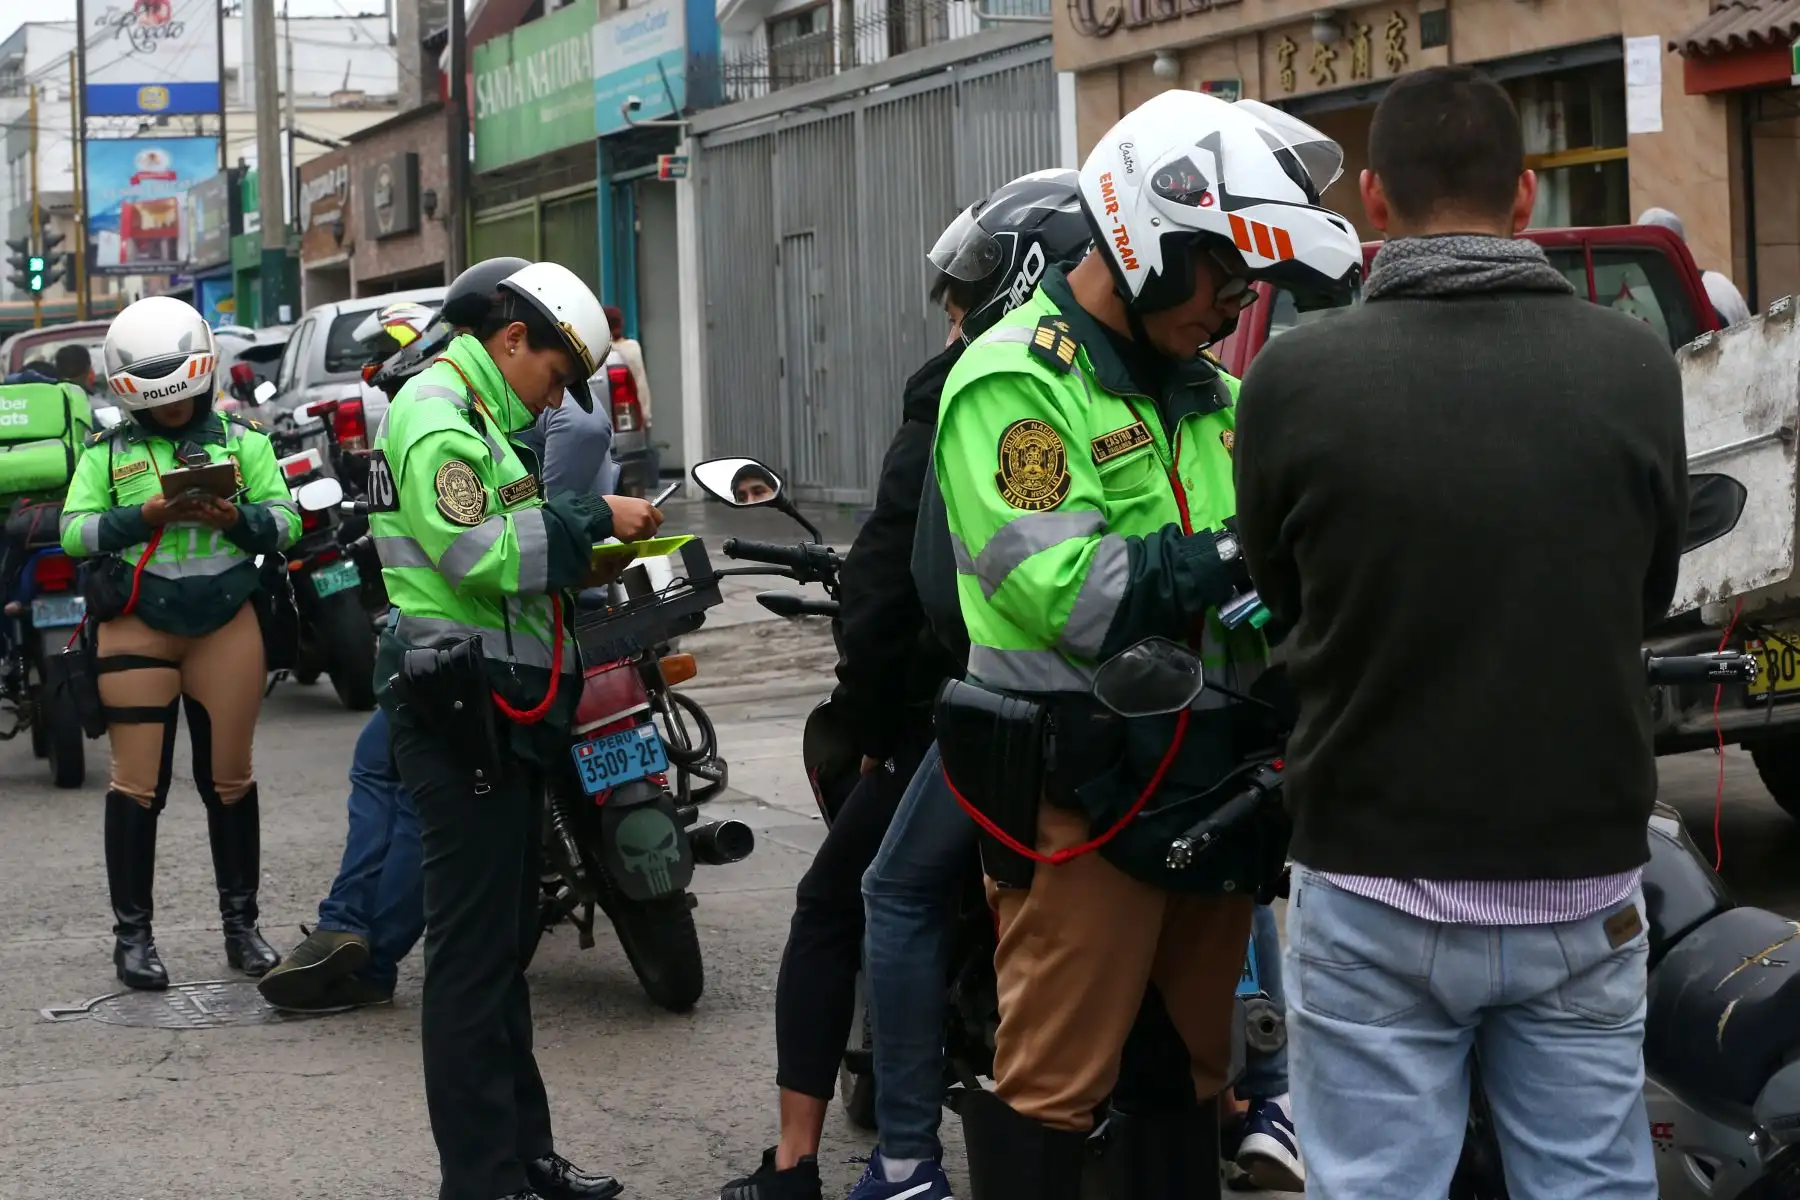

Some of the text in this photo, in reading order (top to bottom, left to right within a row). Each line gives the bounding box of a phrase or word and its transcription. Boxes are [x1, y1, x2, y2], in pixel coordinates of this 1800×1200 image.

[476, 61, 524, 119] SANTA
[526, 31, 595, 101] NATURA
[1118, 142, 1134, 174] Castro
[1002, 241, 1045, 316] HIRO
[142, 380, 188, 400] POLICIA
[0, 396, 28, 411] ber
[0, 412, 29, 426] ats
[1003, 422, 1063, 453] POLICIA NACIONAL
[1104, 429, 1132, 448] CASTRO
[368, 459, 393, 507] TO
[1007, 476, 1028, 496] PUEBLO
[1031, 487, 1052, 498] HECHO
[1002, 488, 1060, 509] DIRTTSV
[599, 733, 633, 752] PERU
[582, 738, 659, 783] 3509-2F
